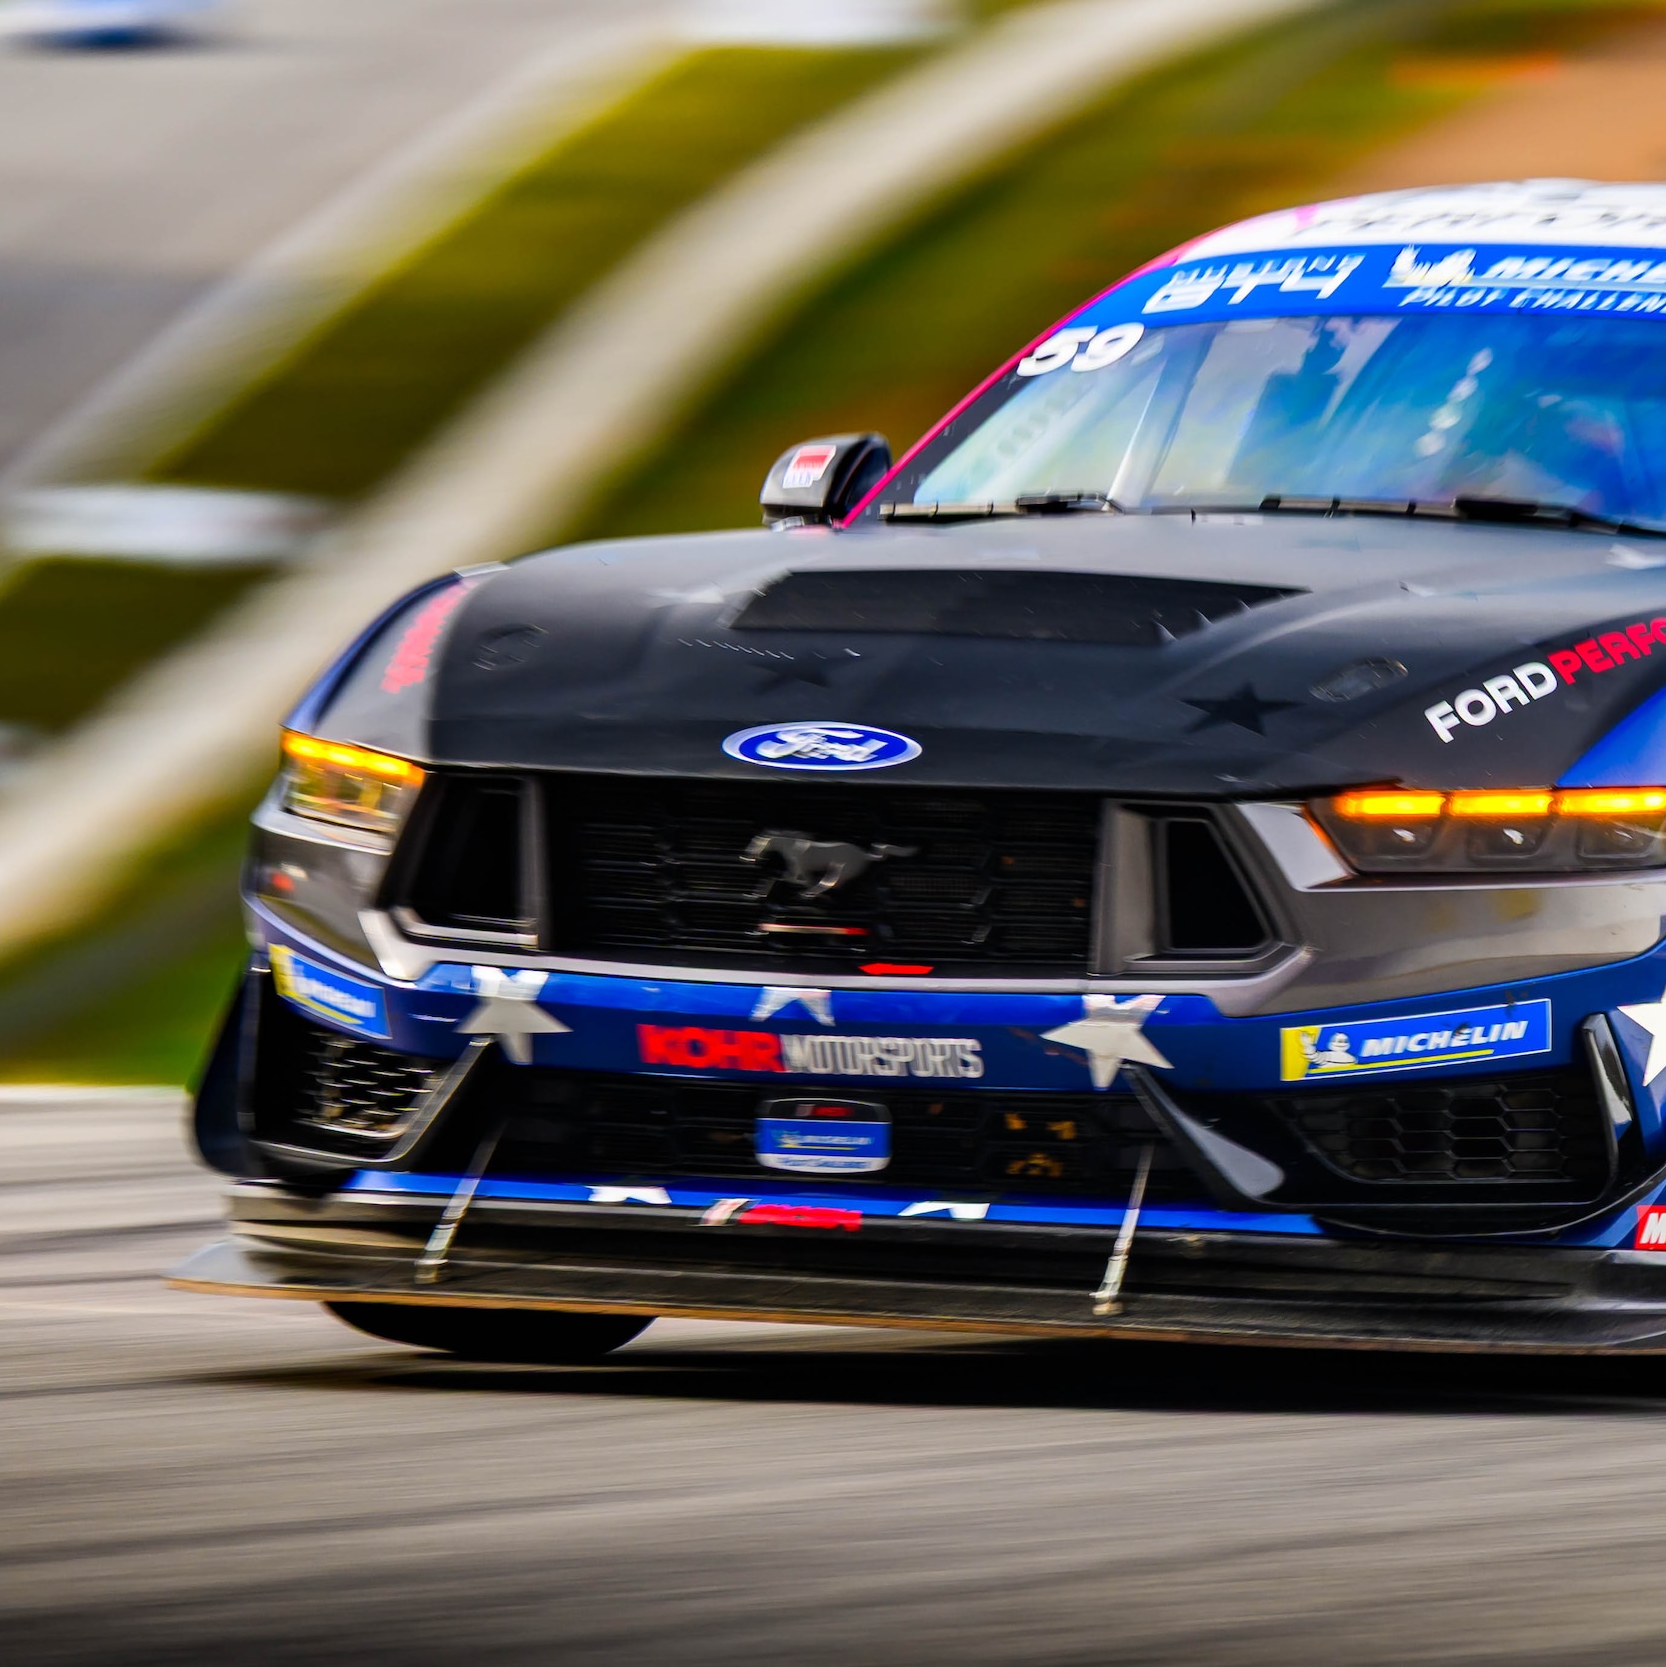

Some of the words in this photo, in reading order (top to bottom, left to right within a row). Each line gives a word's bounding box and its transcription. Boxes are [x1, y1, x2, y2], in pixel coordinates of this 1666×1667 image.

[1016, 322, 1145, 377] 59
[1424, 661, 1558, 744] FORD
[636, 1024, 787, 1073] KOHR
[1360, 1026, 1529, 1058] MICHELIN
